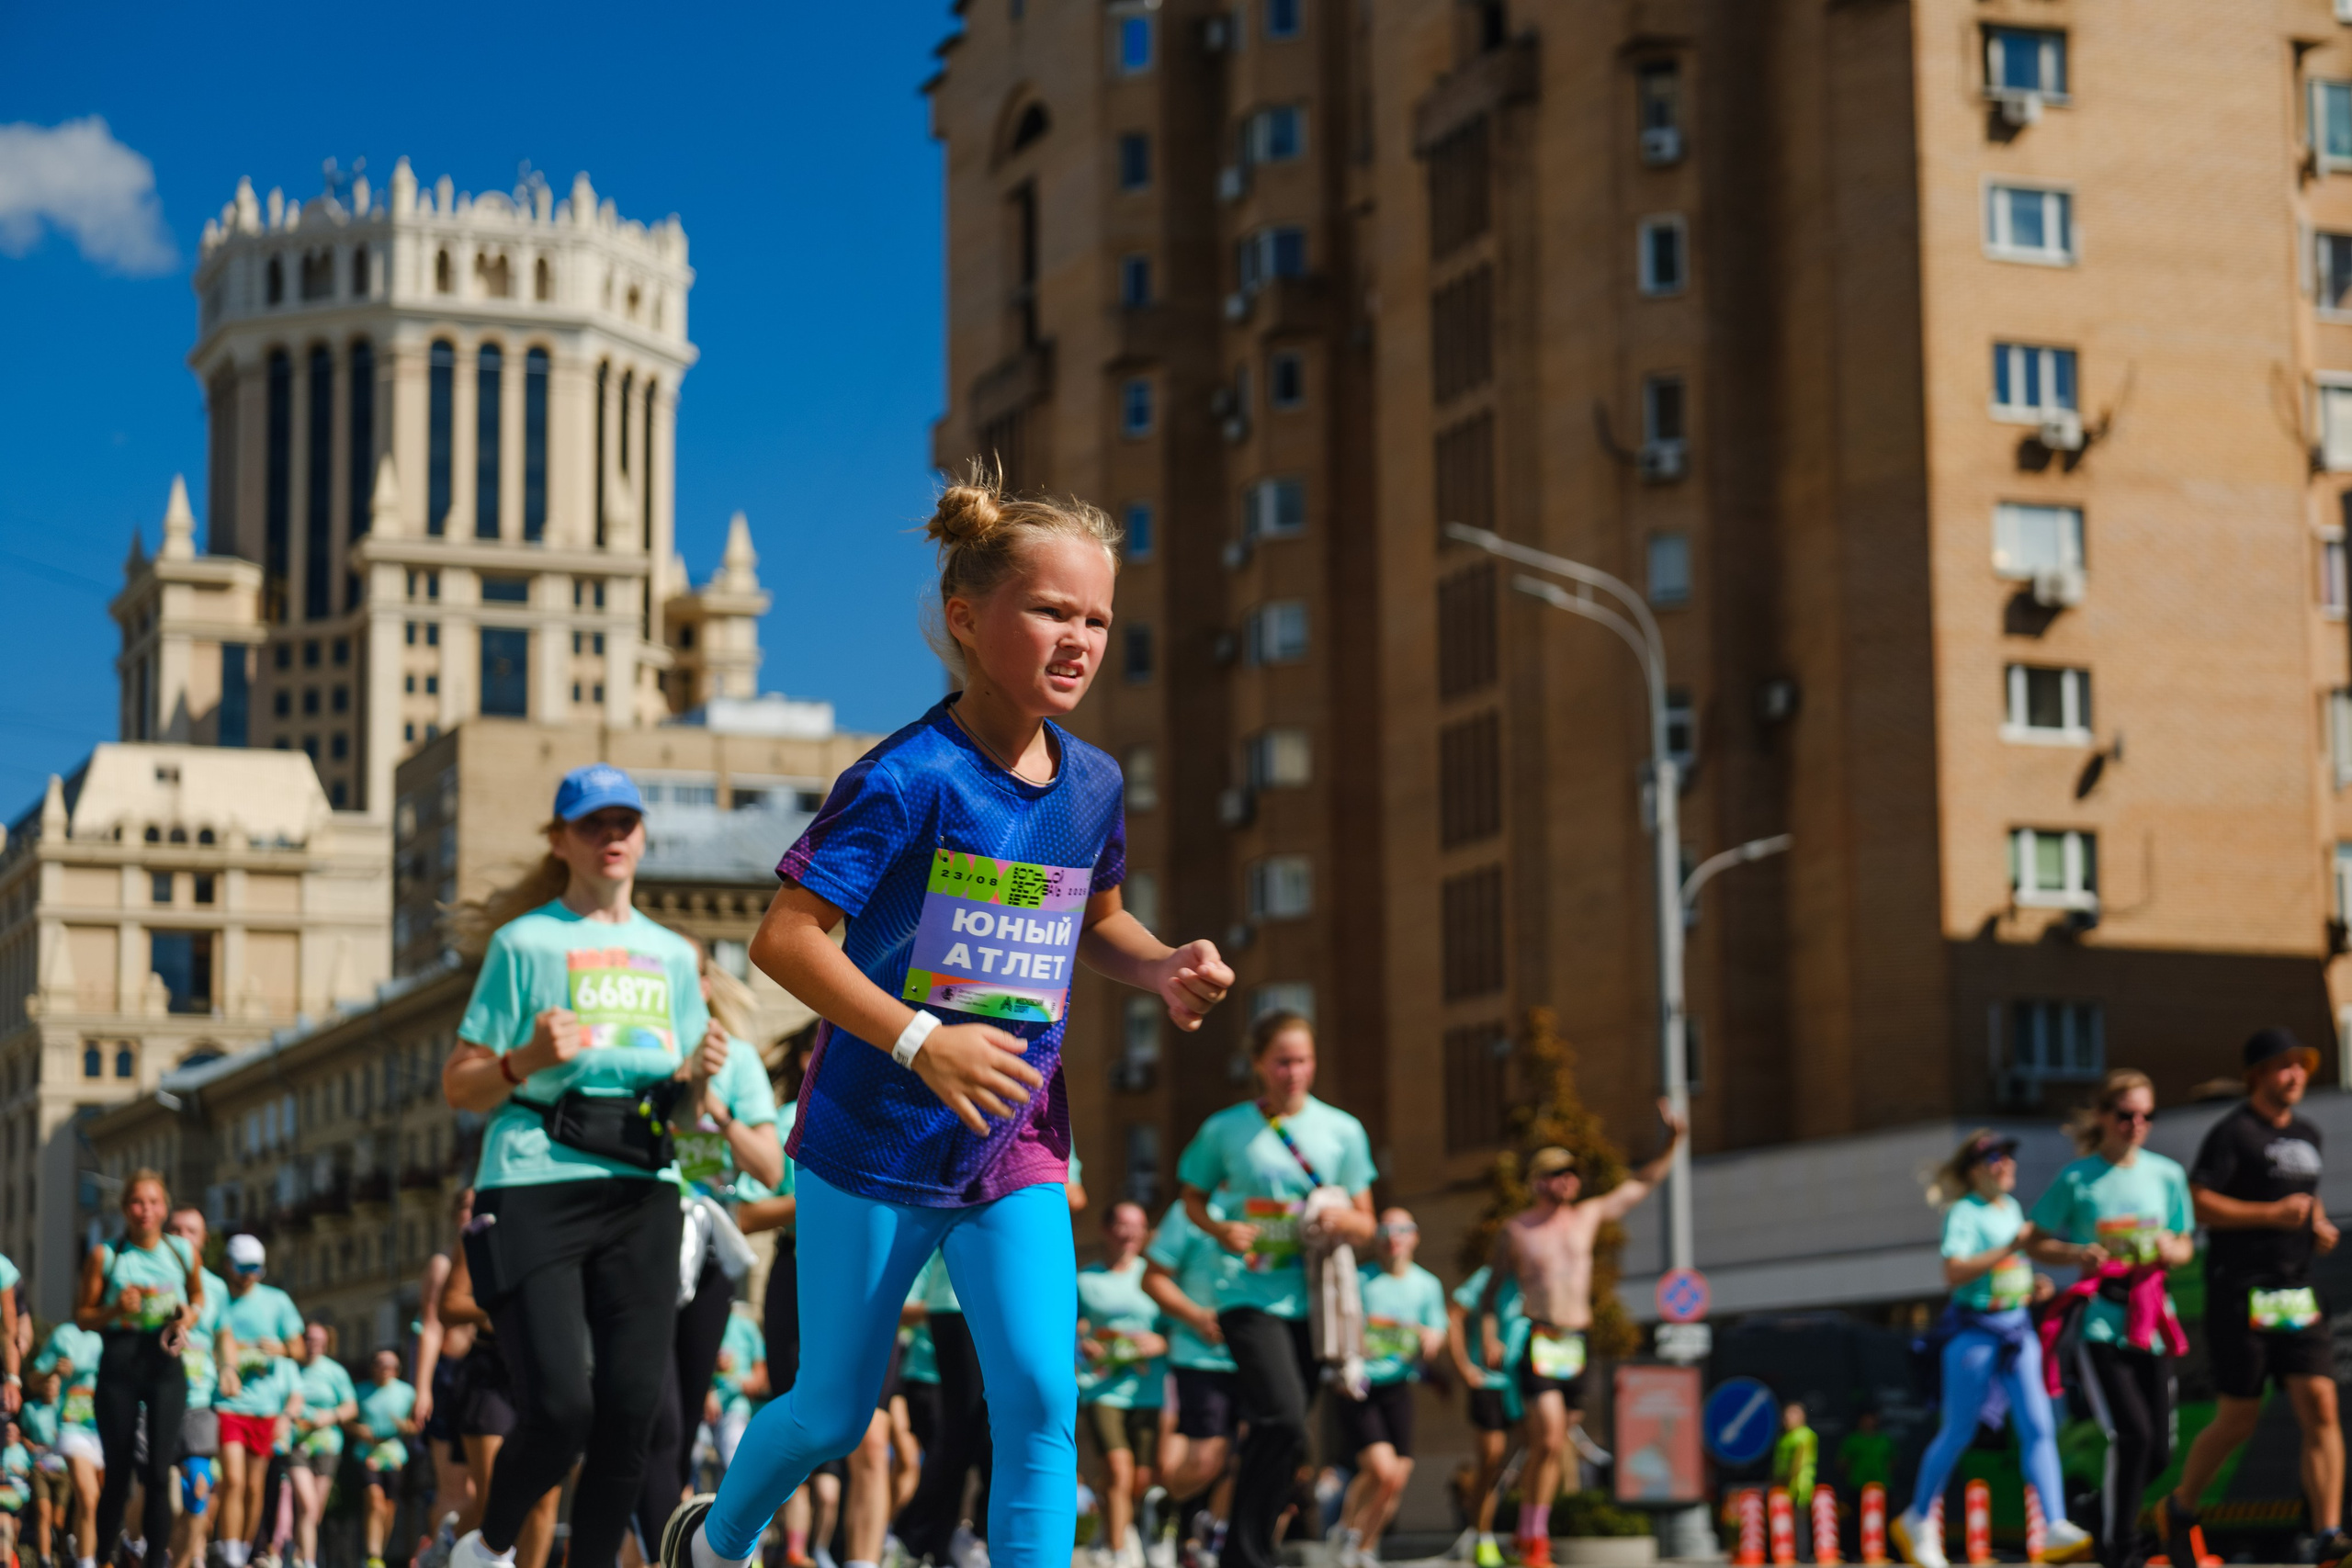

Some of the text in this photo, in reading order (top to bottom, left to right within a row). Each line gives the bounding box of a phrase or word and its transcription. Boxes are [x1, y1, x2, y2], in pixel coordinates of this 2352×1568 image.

[941, 869, 999, 886] 23/08
[951, 908, 1072, 946] ЮНЫЙ
[942, 942, 1067, 980] АТЛЕТ
[577, 975, 666, 1013] 66877
